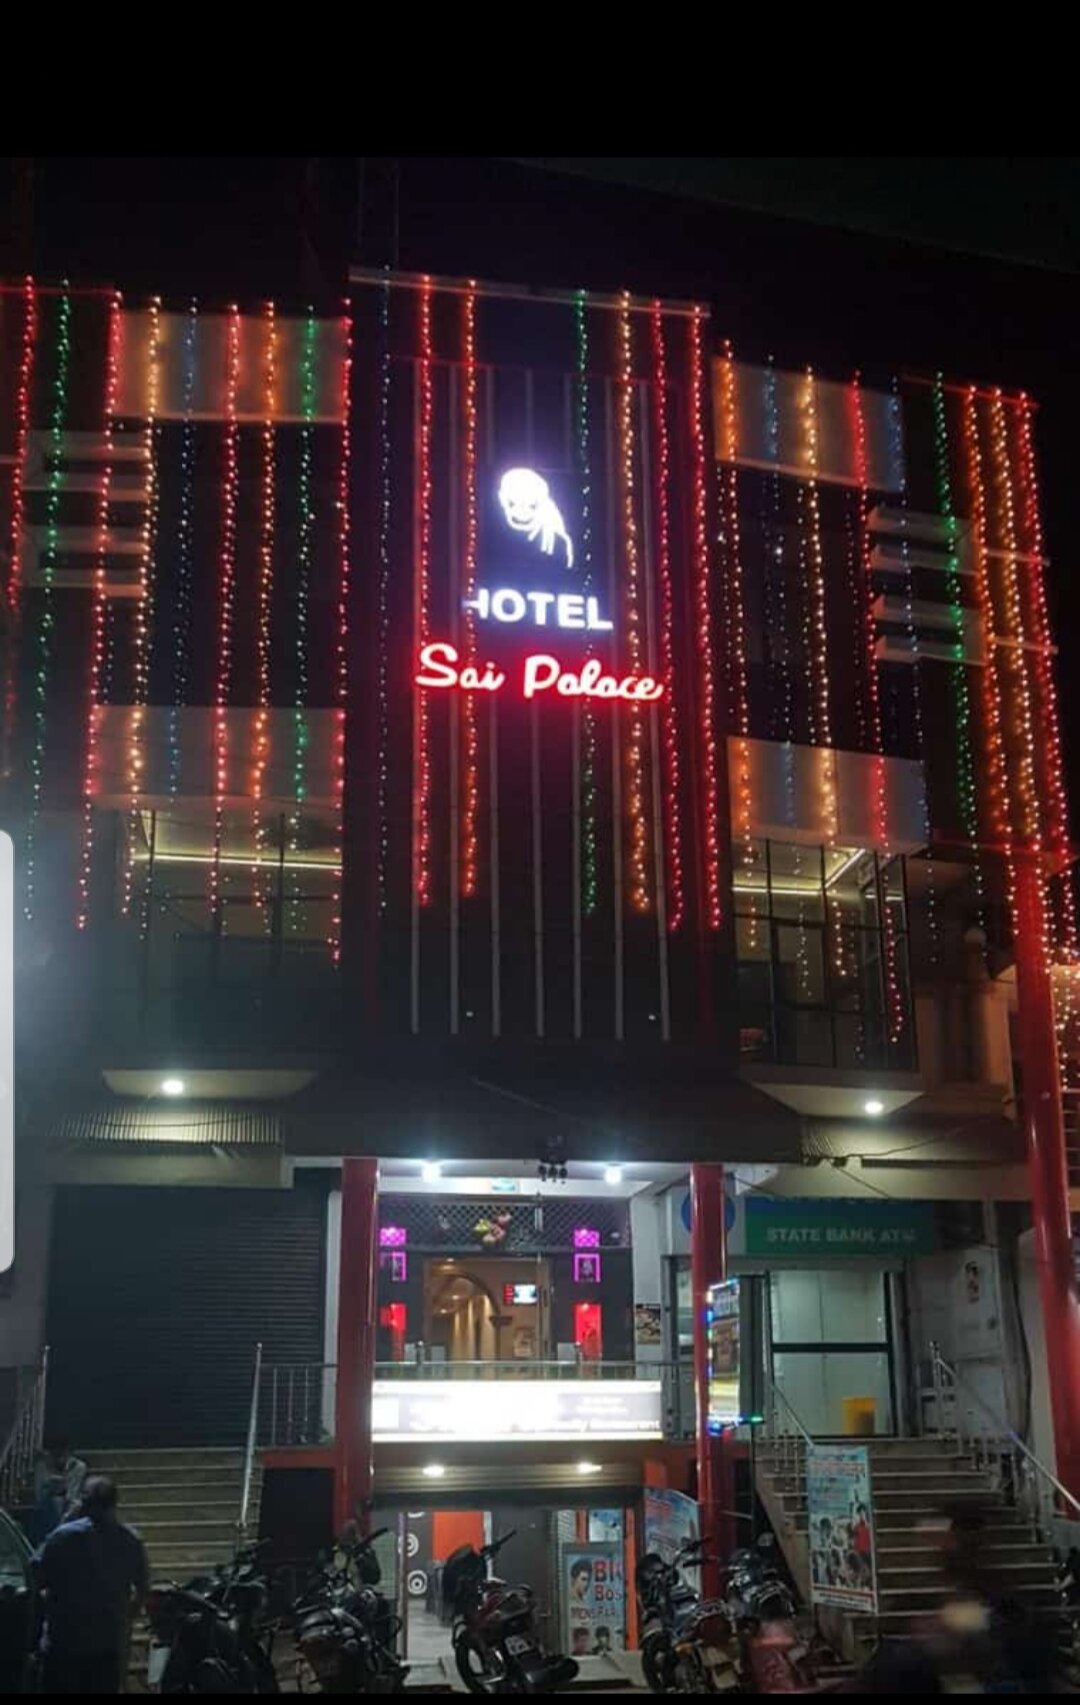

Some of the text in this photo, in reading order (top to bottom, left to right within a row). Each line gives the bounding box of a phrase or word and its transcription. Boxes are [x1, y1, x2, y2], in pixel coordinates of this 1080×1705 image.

[461, 588, 613, 630] HOTEL
[416, 643, 663, 699] Sai Palace
[766, 1227, 821, 1242] STATE
[825, 1228, 875, 1242] BANK
